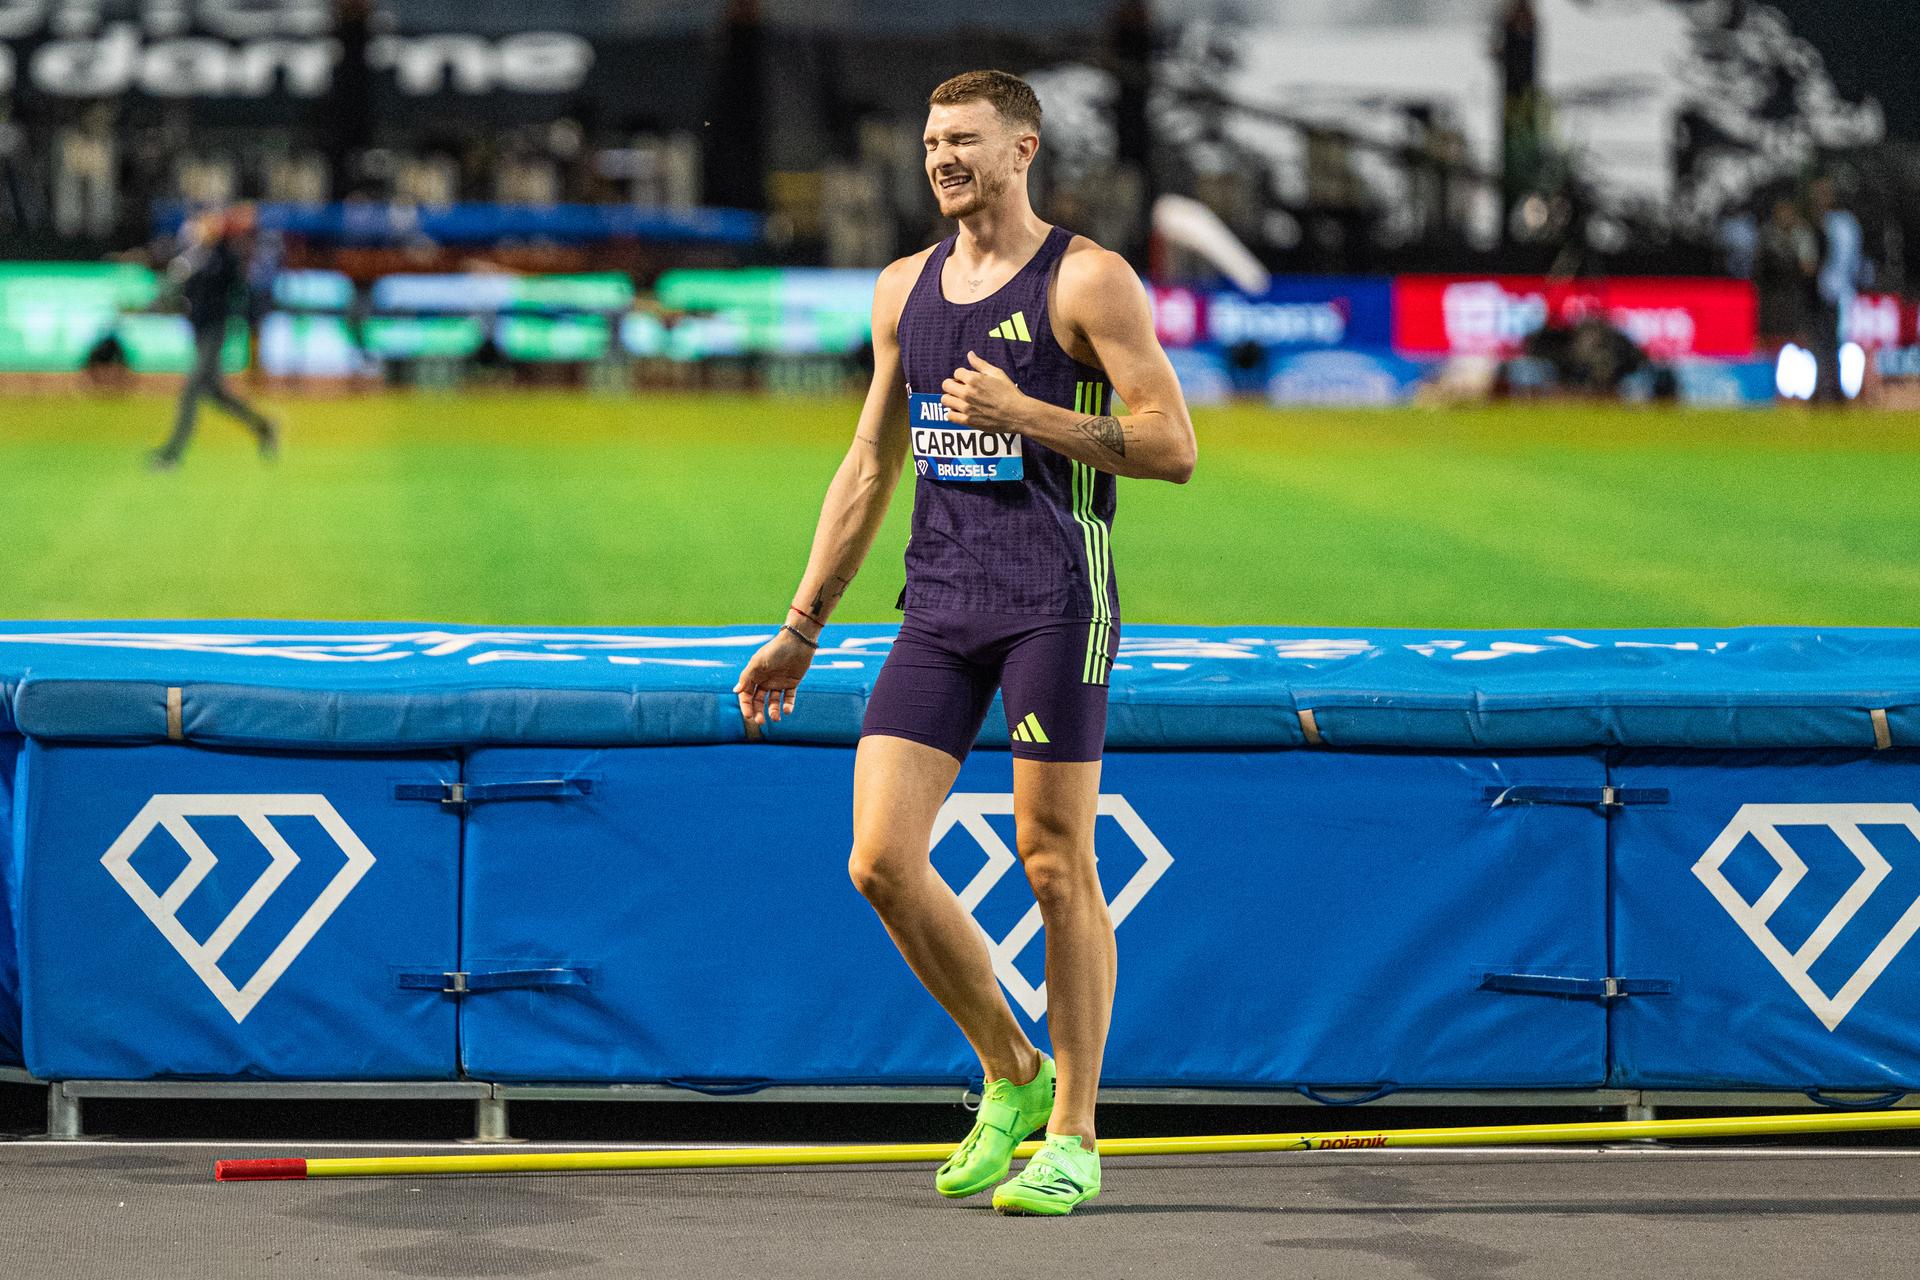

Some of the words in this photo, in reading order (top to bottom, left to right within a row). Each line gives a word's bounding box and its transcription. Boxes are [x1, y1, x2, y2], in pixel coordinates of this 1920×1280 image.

[920, 401, 951, 421] Allia
[915, 430, 1017, 457] CARMOY
[937, 463, 998, 478] BRUSSELS
